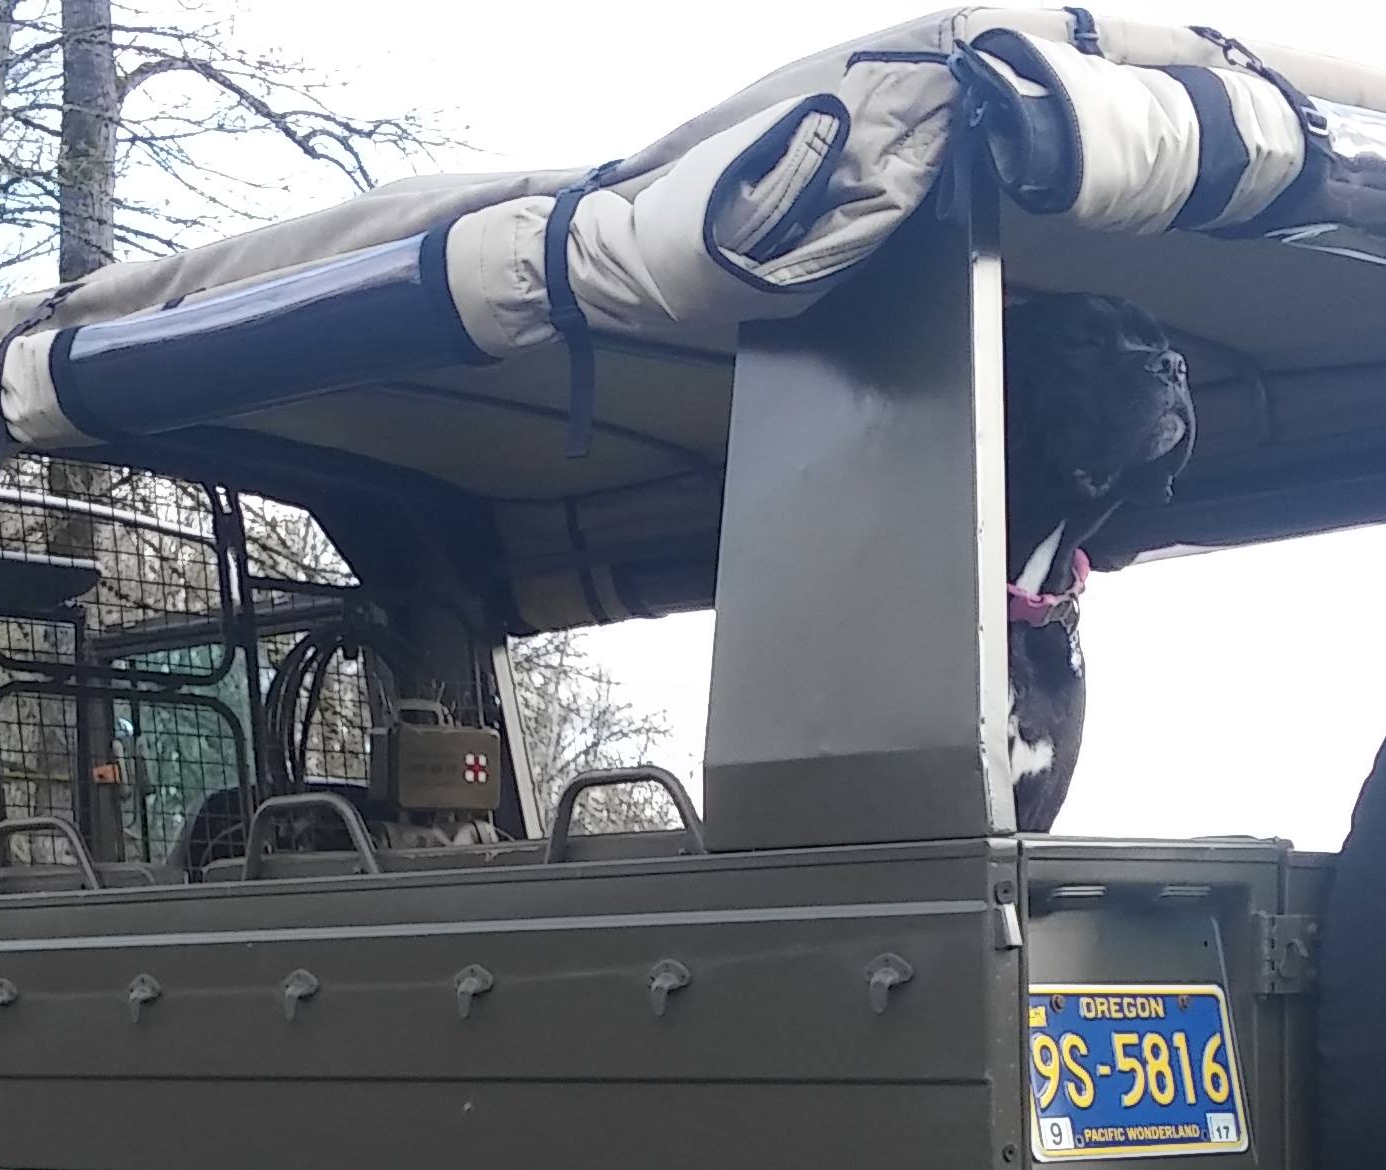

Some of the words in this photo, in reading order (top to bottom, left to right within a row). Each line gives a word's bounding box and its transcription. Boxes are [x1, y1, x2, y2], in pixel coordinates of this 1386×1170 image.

[1079, 997, 1165, 1019] OREGON
[1031, 1032, 1230, 1110] 9S-5816
[1051, 1122, 1063, 1146] 9
[1084, 1128, 1125, 1141] PACIFIC
[1127, 1125, 1200, 1140] WONDERLAND
[1216, 1126, 1230, 1140] 17
